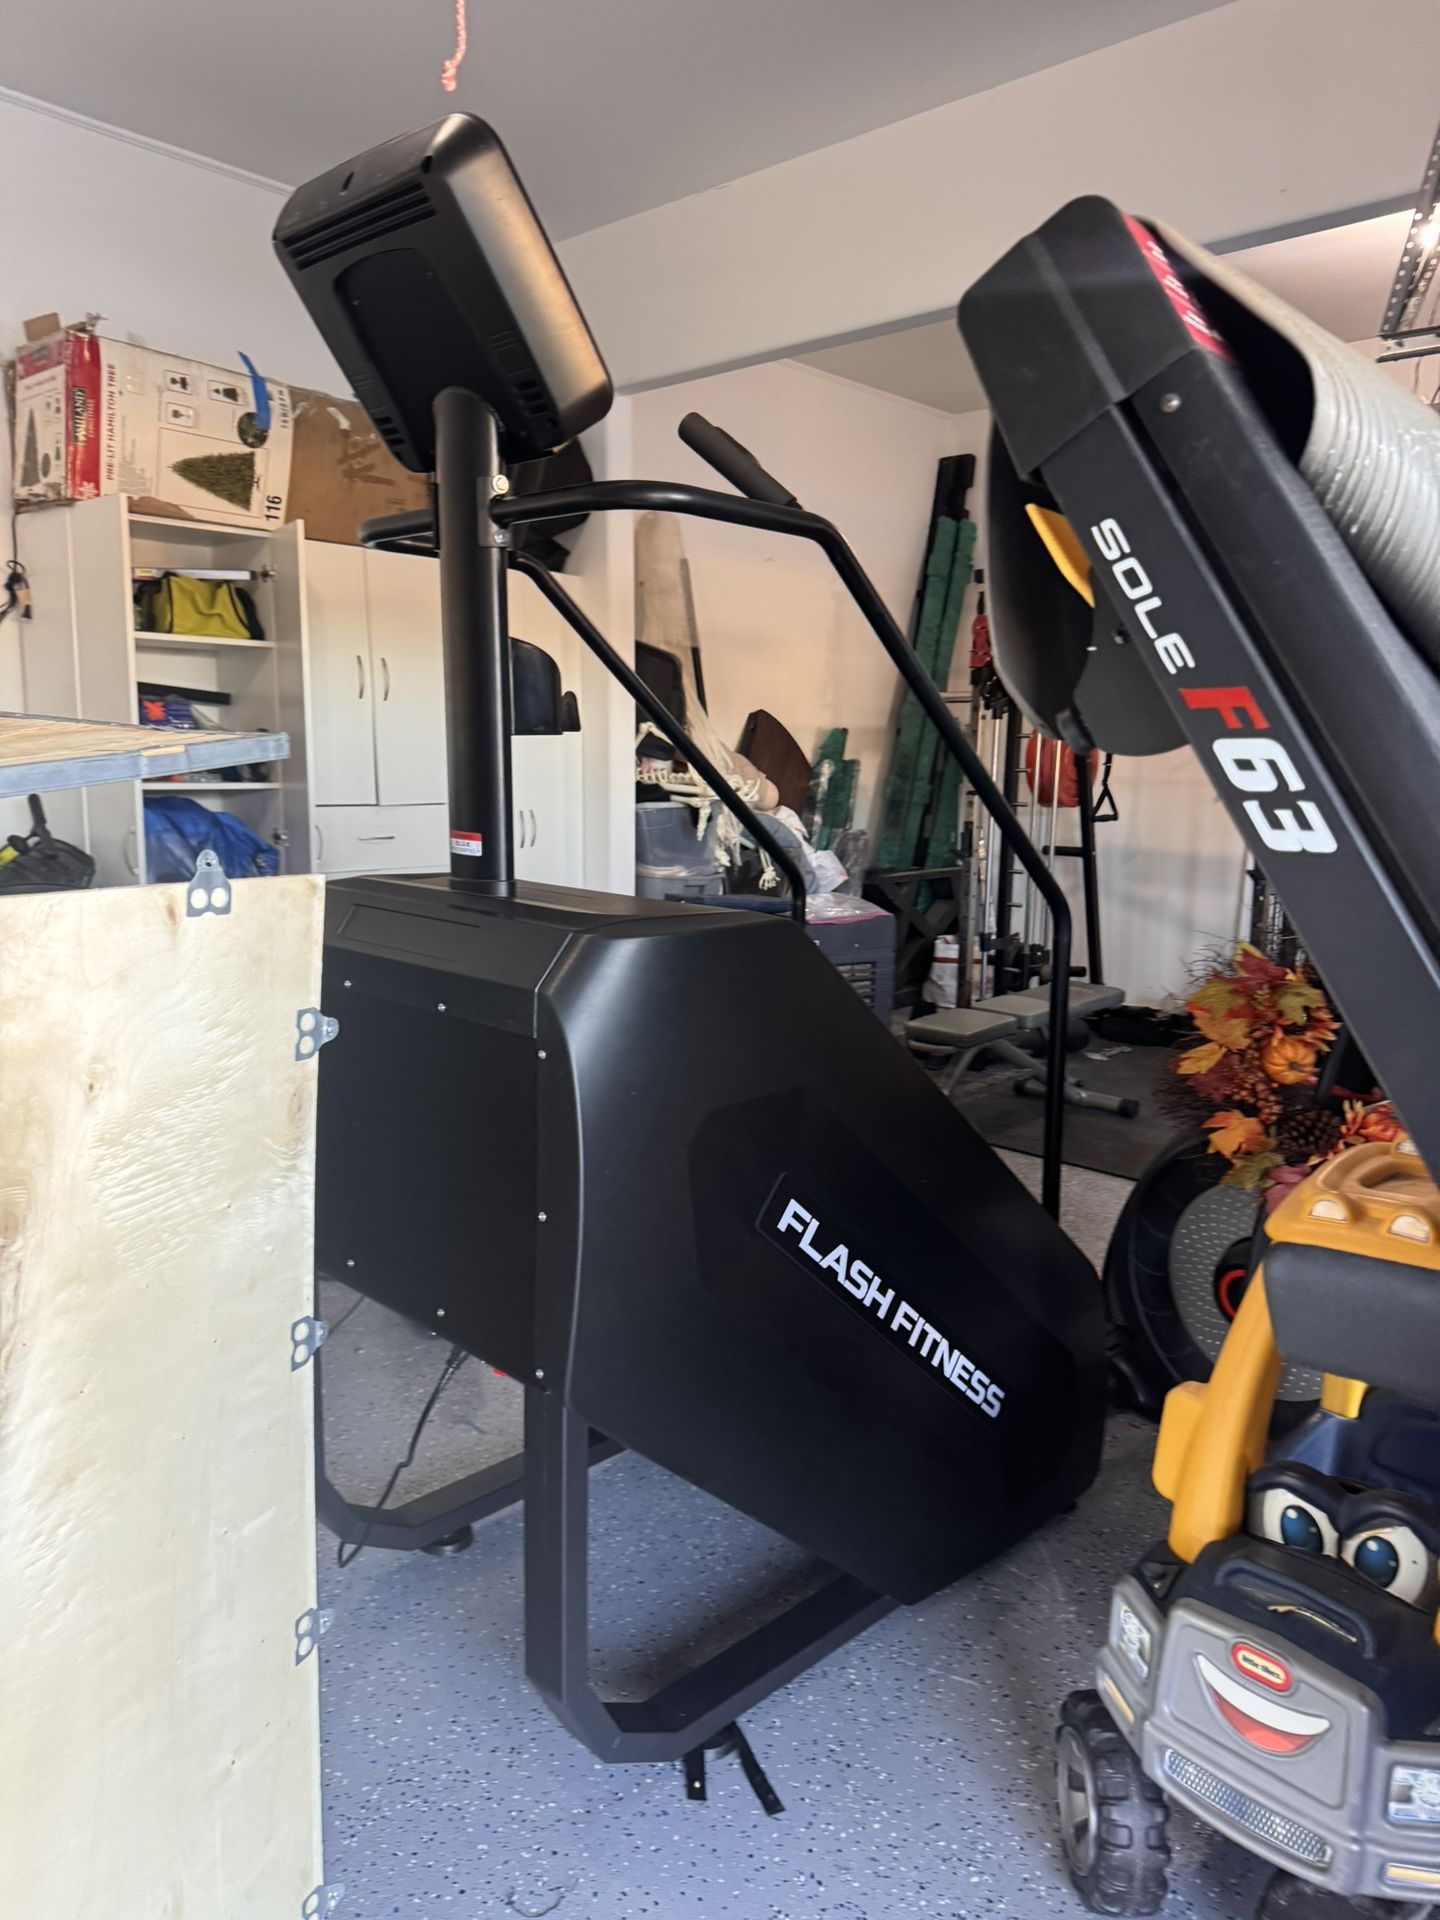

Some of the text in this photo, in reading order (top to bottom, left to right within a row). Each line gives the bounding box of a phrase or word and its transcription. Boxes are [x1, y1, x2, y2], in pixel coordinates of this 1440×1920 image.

[106, 364, 116, 481] PRE-LIT HAMILTON TREE
[265, 495, 282, 520] 116
[1090, 518, 1196, 674] SOLE
[777, 1198, 1005, 1418] FLASH FITNESS
